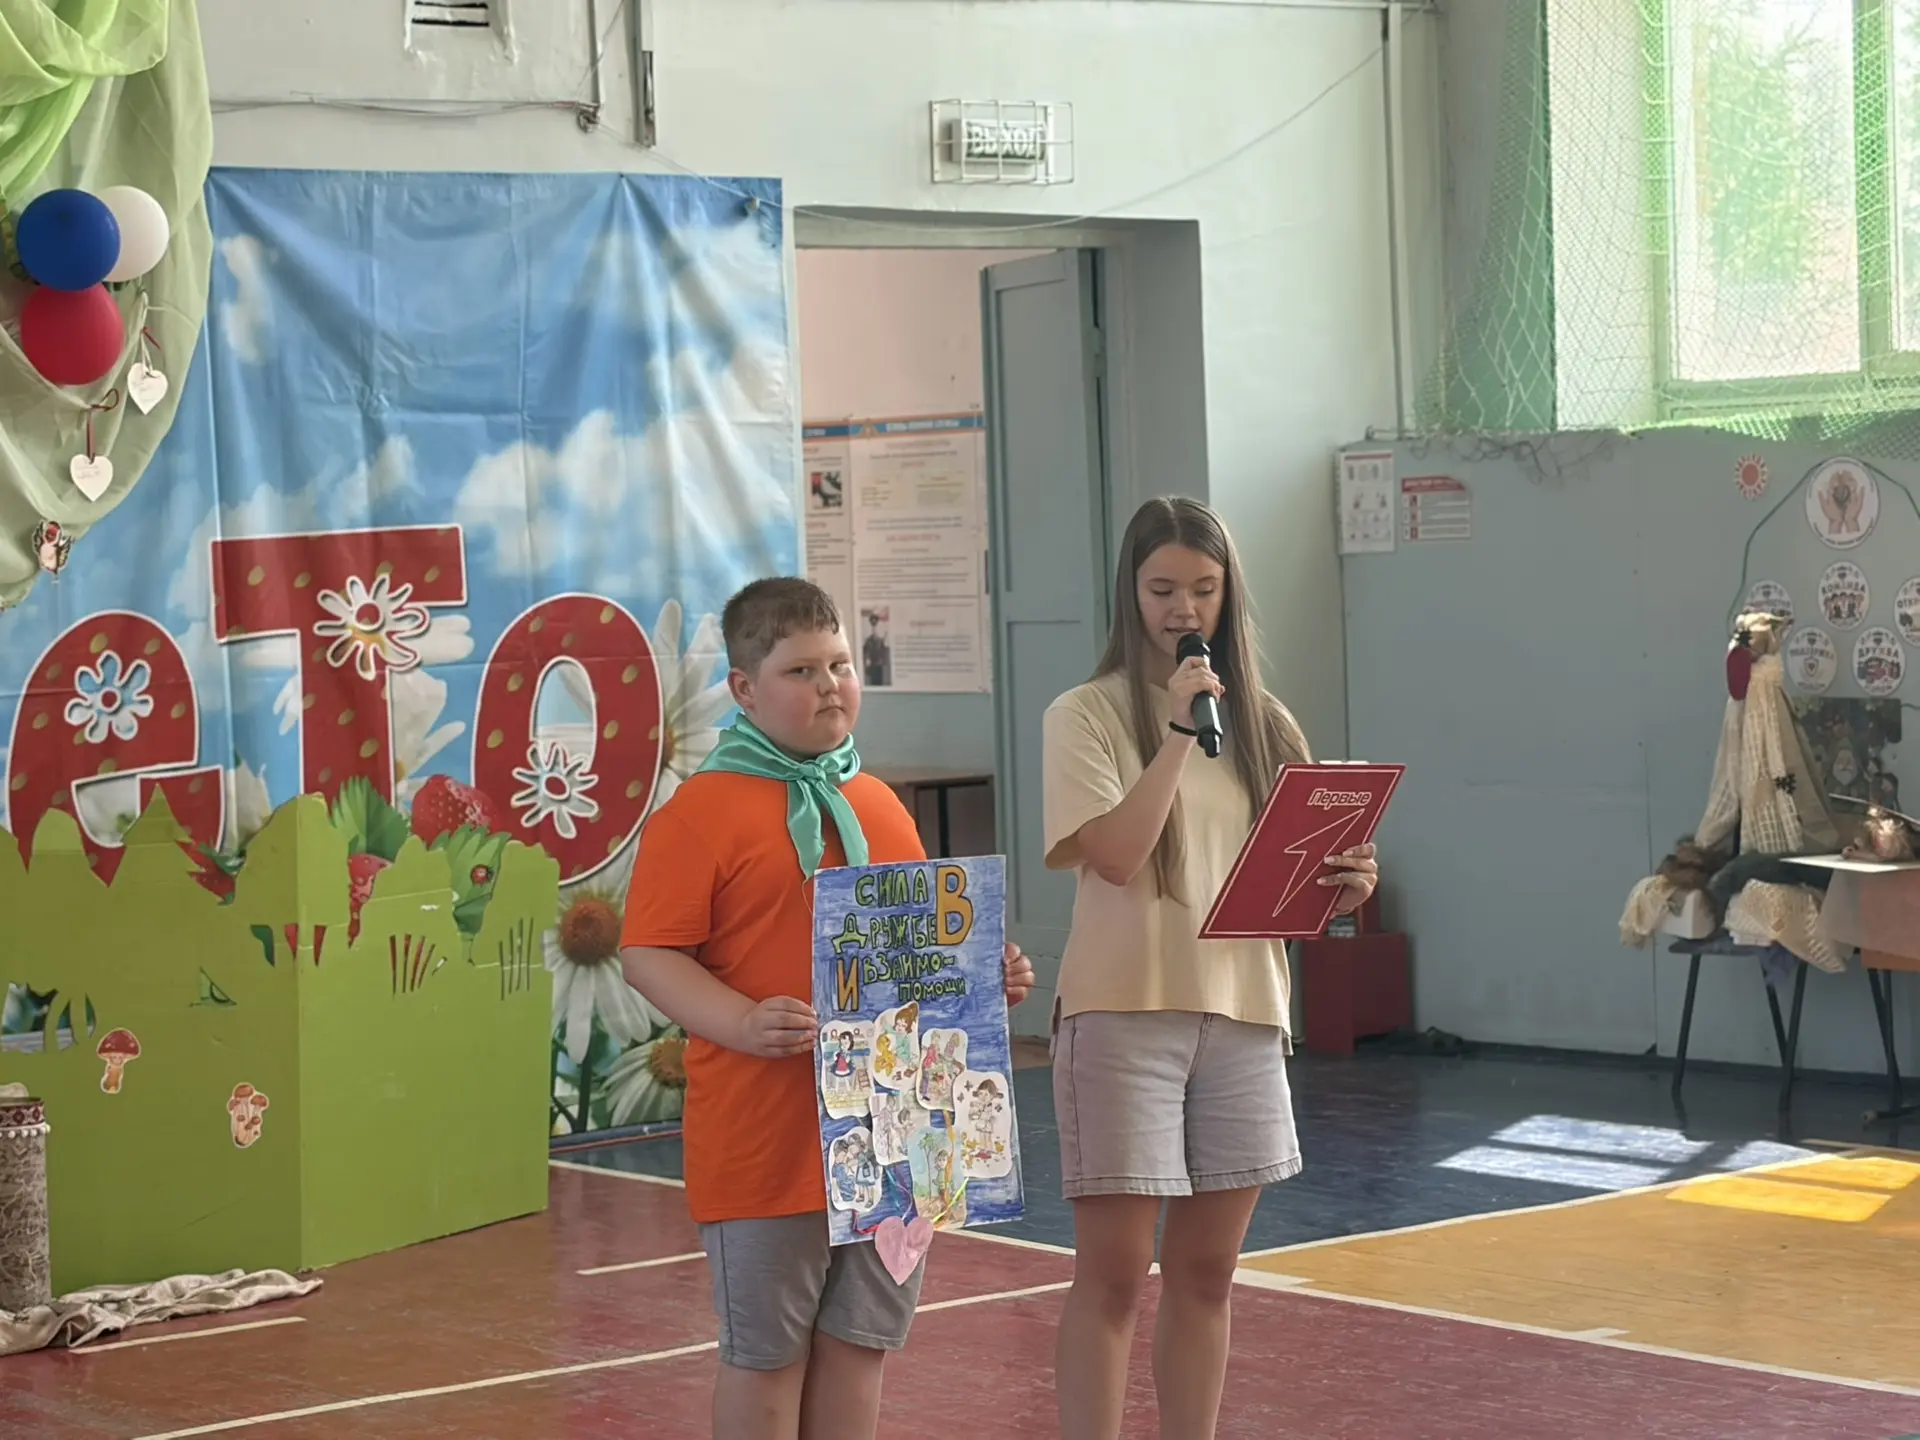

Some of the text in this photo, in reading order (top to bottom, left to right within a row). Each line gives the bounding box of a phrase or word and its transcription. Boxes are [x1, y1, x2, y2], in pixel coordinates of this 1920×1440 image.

[1307, 788, 1372, 810] Первые
[855, 864, 973, 946] СИЛА В
[831, 913, 937, 954] ДРУЖБЕ
[836, 956, 860, 1012] И
